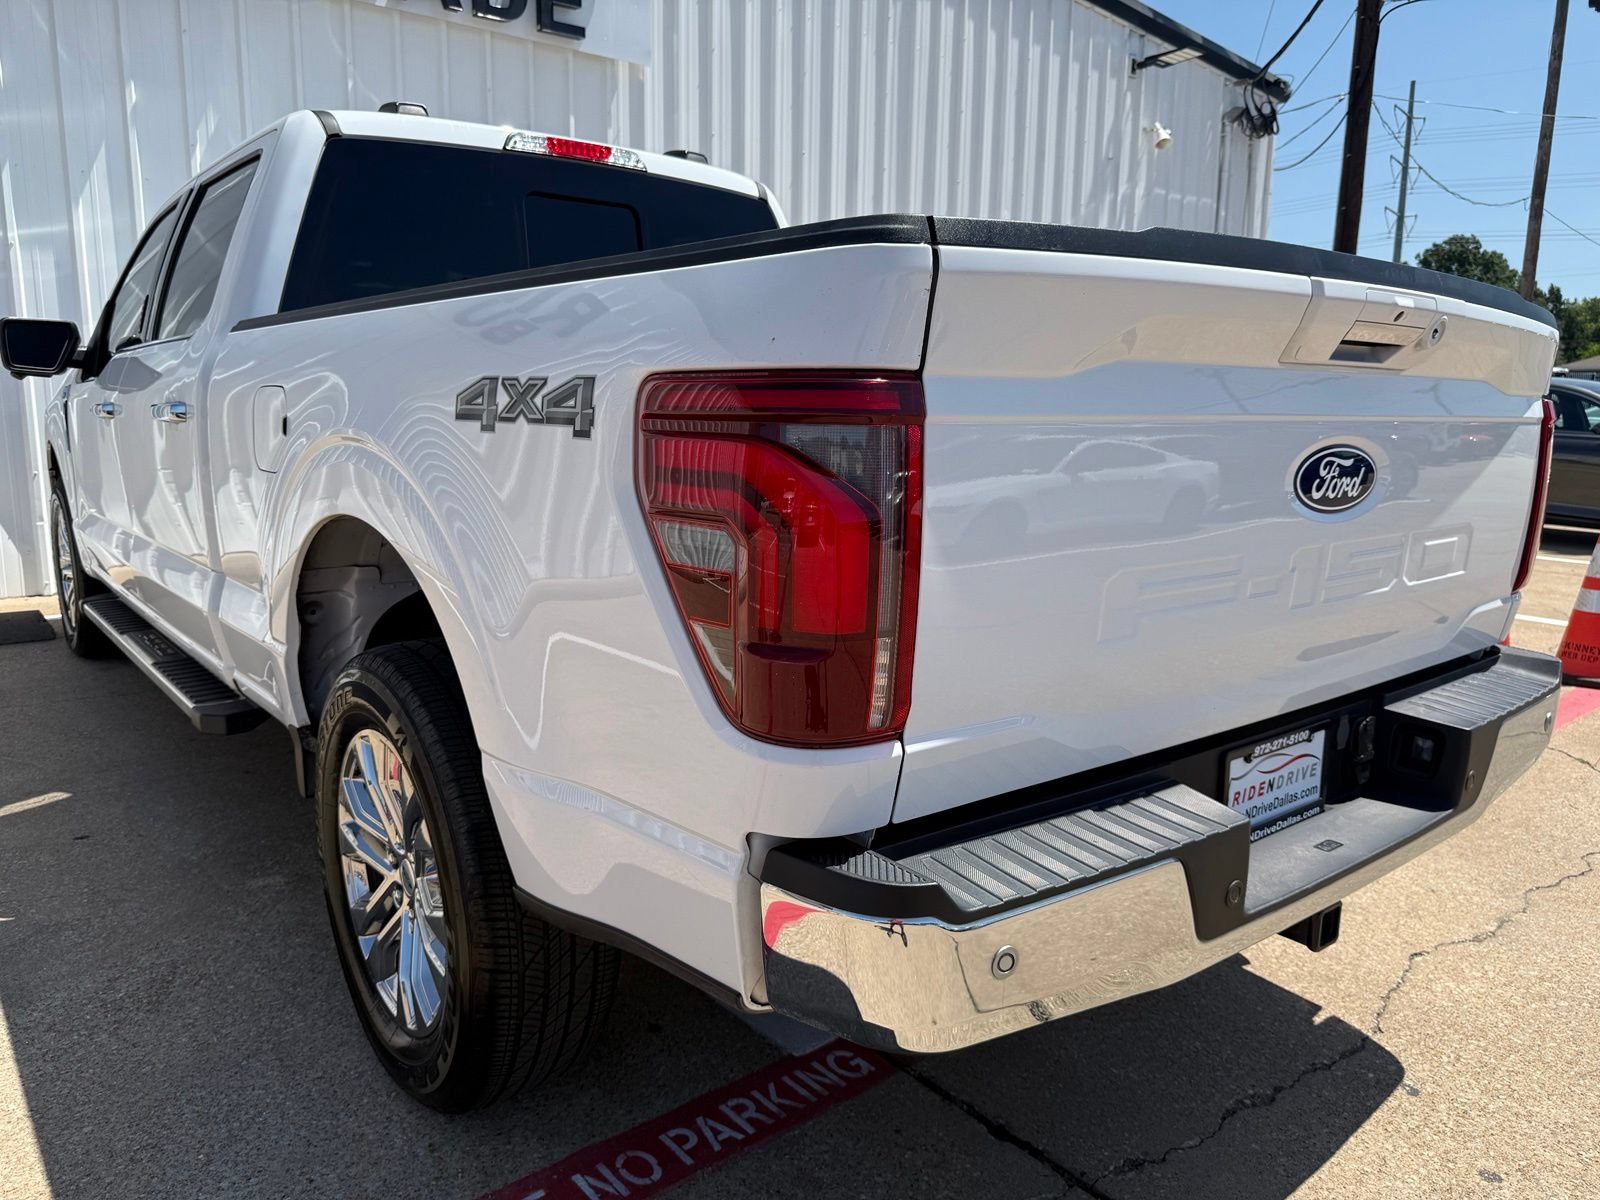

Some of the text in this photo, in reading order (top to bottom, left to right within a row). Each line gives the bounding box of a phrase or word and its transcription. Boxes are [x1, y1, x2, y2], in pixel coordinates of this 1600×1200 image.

[1311, 456, 1365, 500] Ford
[1098, 522, 1474, 645] F-150
[1253, 729, 1310, 757] 972-271-5100
[571, 1049, 876, 1200] NO PARKING
